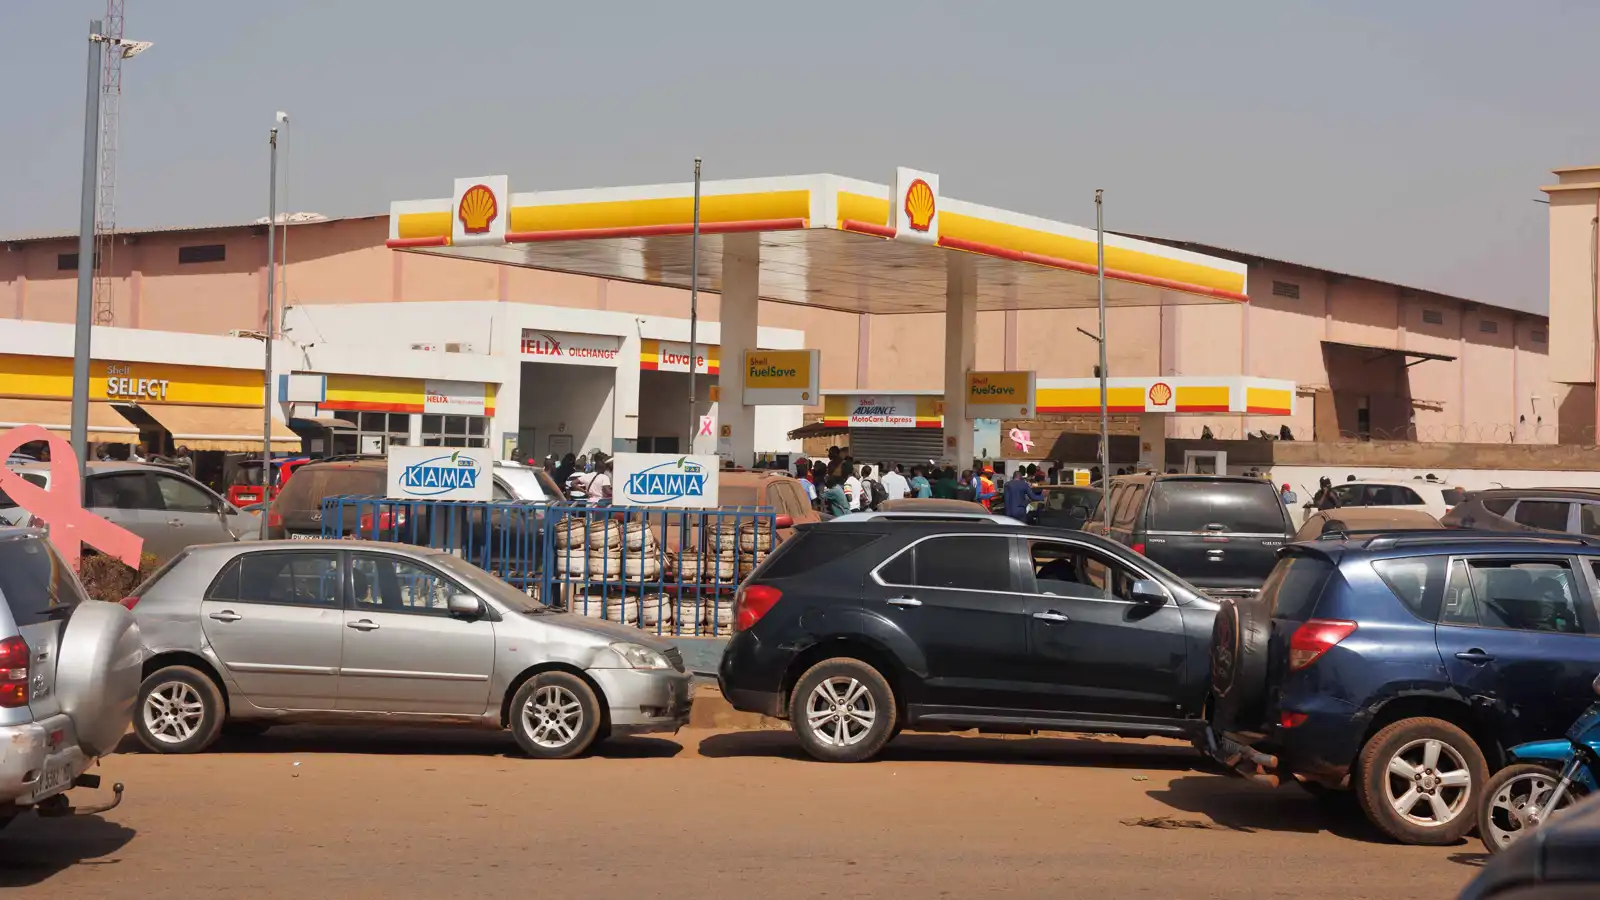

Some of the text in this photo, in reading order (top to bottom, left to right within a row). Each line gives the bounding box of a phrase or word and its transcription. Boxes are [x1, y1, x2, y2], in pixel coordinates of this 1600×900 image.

[662, 349, 704, 367] Lavae
[750, 357, 768, 366] Shell
[107, 365, 130, 375] Shell
[750, 366, 796, 378] FuelSave
[107, 377, 169, 398] SELECT
[971, 384, 1015, 395] FuelSave
[426, 395, 449, 404] HELIX
[853, 406, 896, 415] ADVANCE
[851, 415, 912, 424] MotoCare Express
[407, 467, 474, 487] KAMA
[632, 474, 702, 494] KAMA
